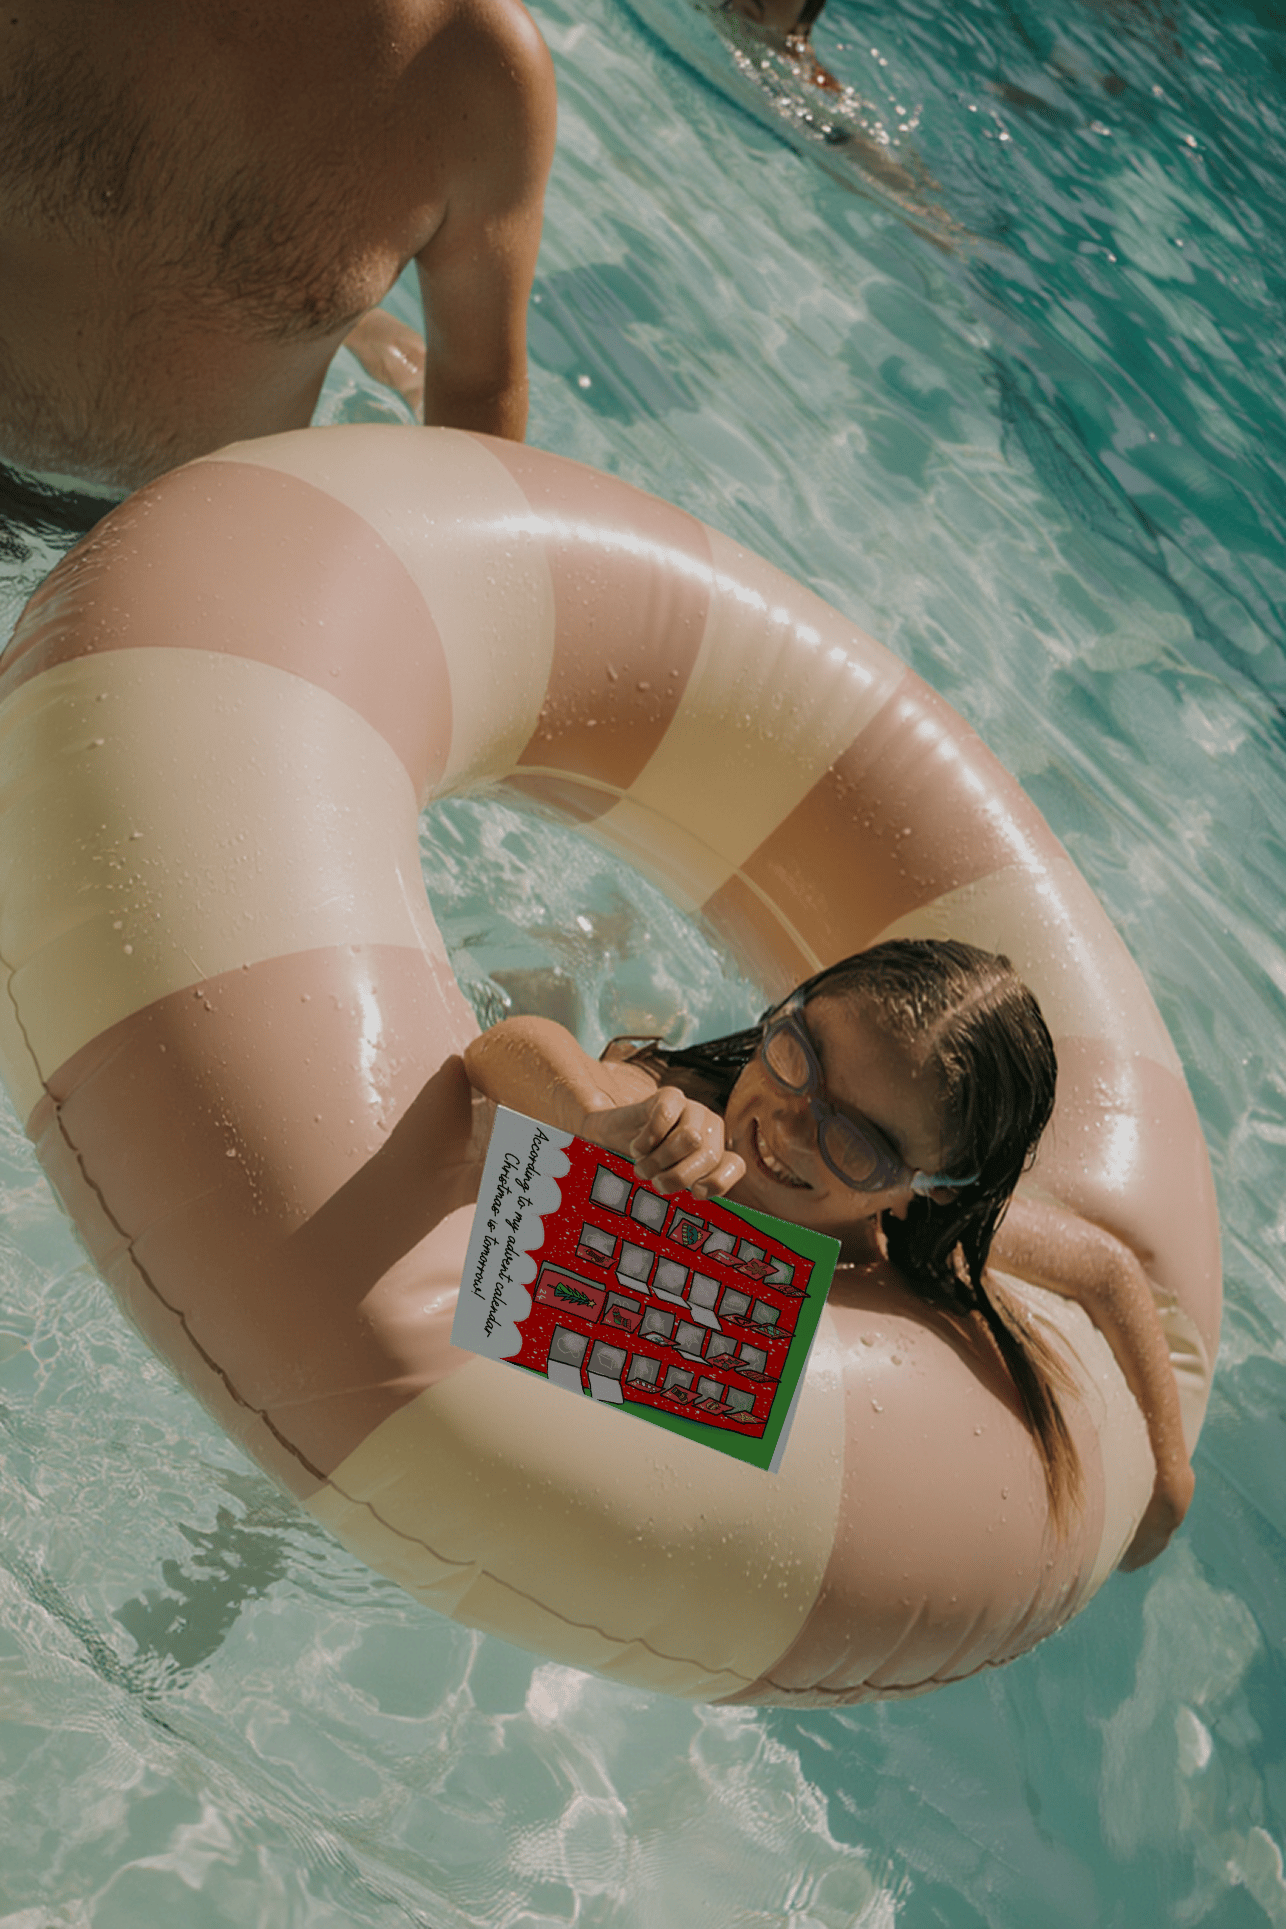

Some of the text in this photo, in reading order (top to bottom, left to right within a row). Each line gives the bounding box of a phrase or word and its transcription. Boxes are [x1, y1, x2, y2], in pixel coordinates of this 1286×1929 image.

[471, 1152, 521, 1301] Christmas is tomorrow!
[484, 1127, 550, 1338] According to my advent calendar
